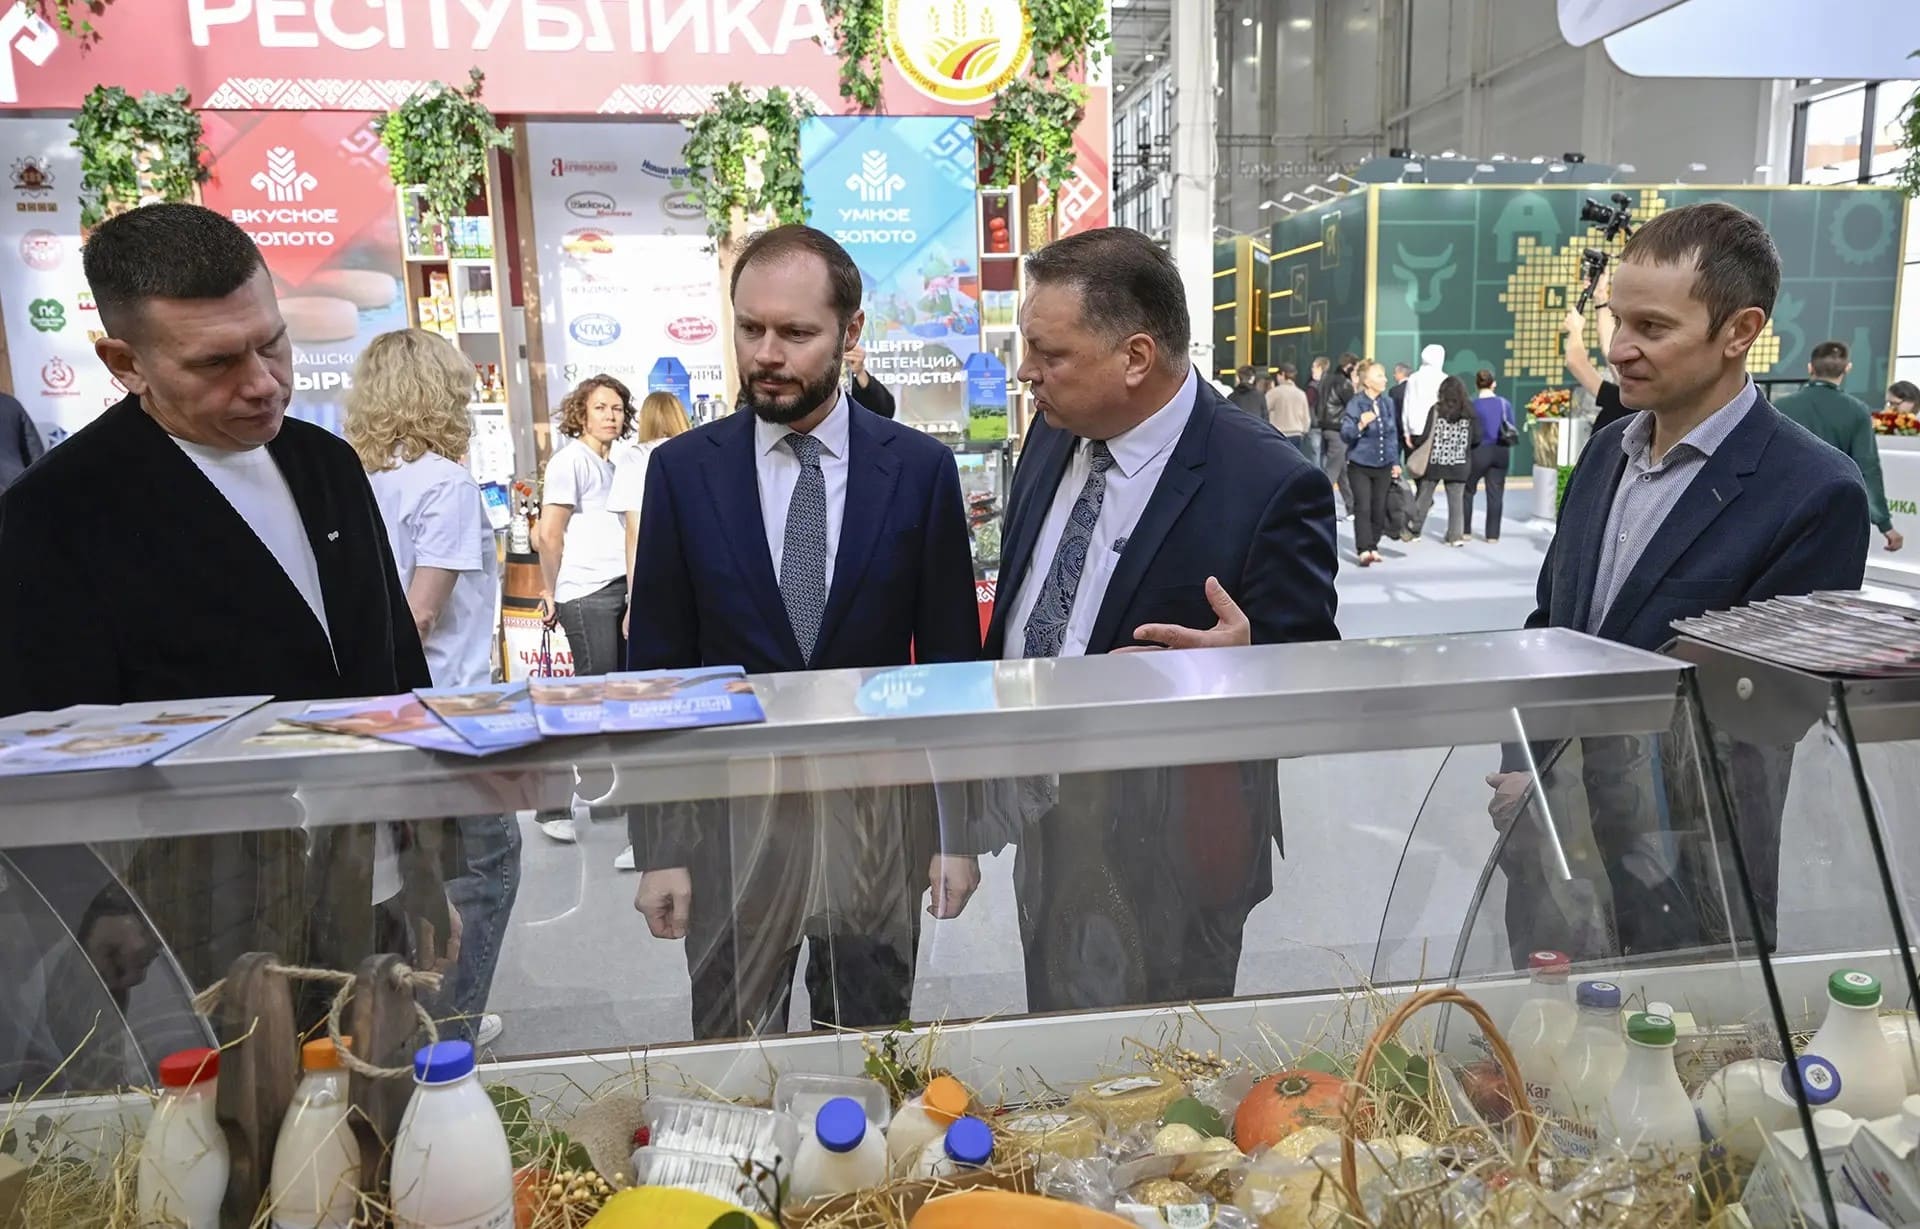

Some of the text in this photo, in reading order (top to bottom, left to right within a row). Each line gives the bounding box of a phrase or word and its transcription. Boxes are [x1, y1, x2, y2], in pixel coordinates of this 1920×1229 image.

[231, 208, 339, 224] ВКУСНОЕ
[838, 208, 911, 222] УМНОЕ
[834, 230, 917, 244] ЗОЛОТО
[865, 340, 924, 354] ЦЕНТР
[864, 355, 957, 369] ПЕТЕНЦИЙ
[875, 372, 965, 385] ЕВОДСТВА
[1889, 499, 1917, 515] ИКА
